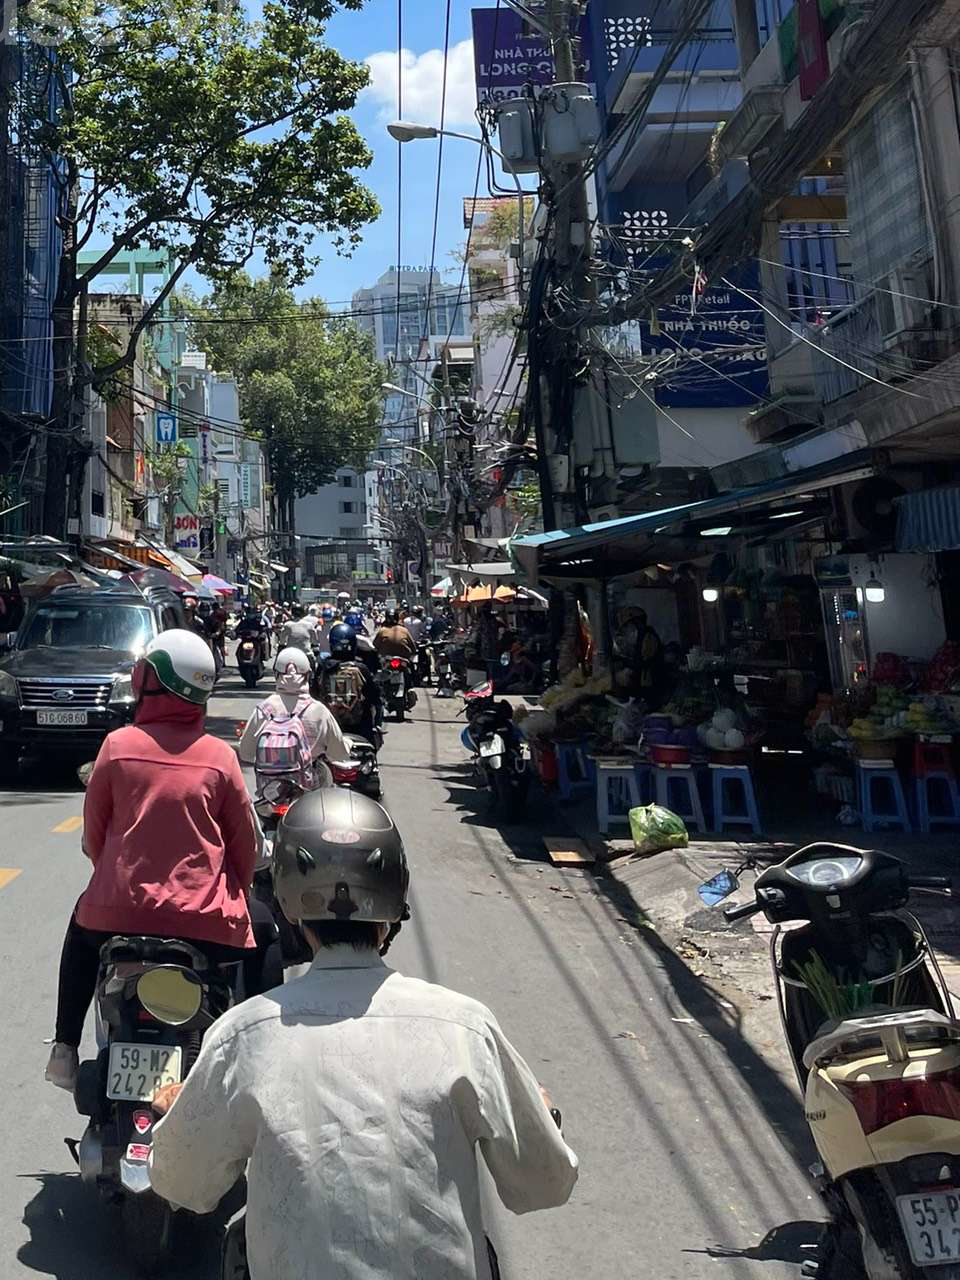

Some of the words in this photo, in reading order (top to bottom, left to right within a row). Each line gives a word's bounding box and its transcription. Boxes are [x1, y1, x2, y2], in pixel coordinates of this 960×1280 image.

[495, 47, 523, 59] NHÀ
[537, 60, 591, 75] CU
[675, 295, 695, 305] FPT
[664, 317, 694, 332] NHÀ
[701, 315, 751, 331] THUỐC
